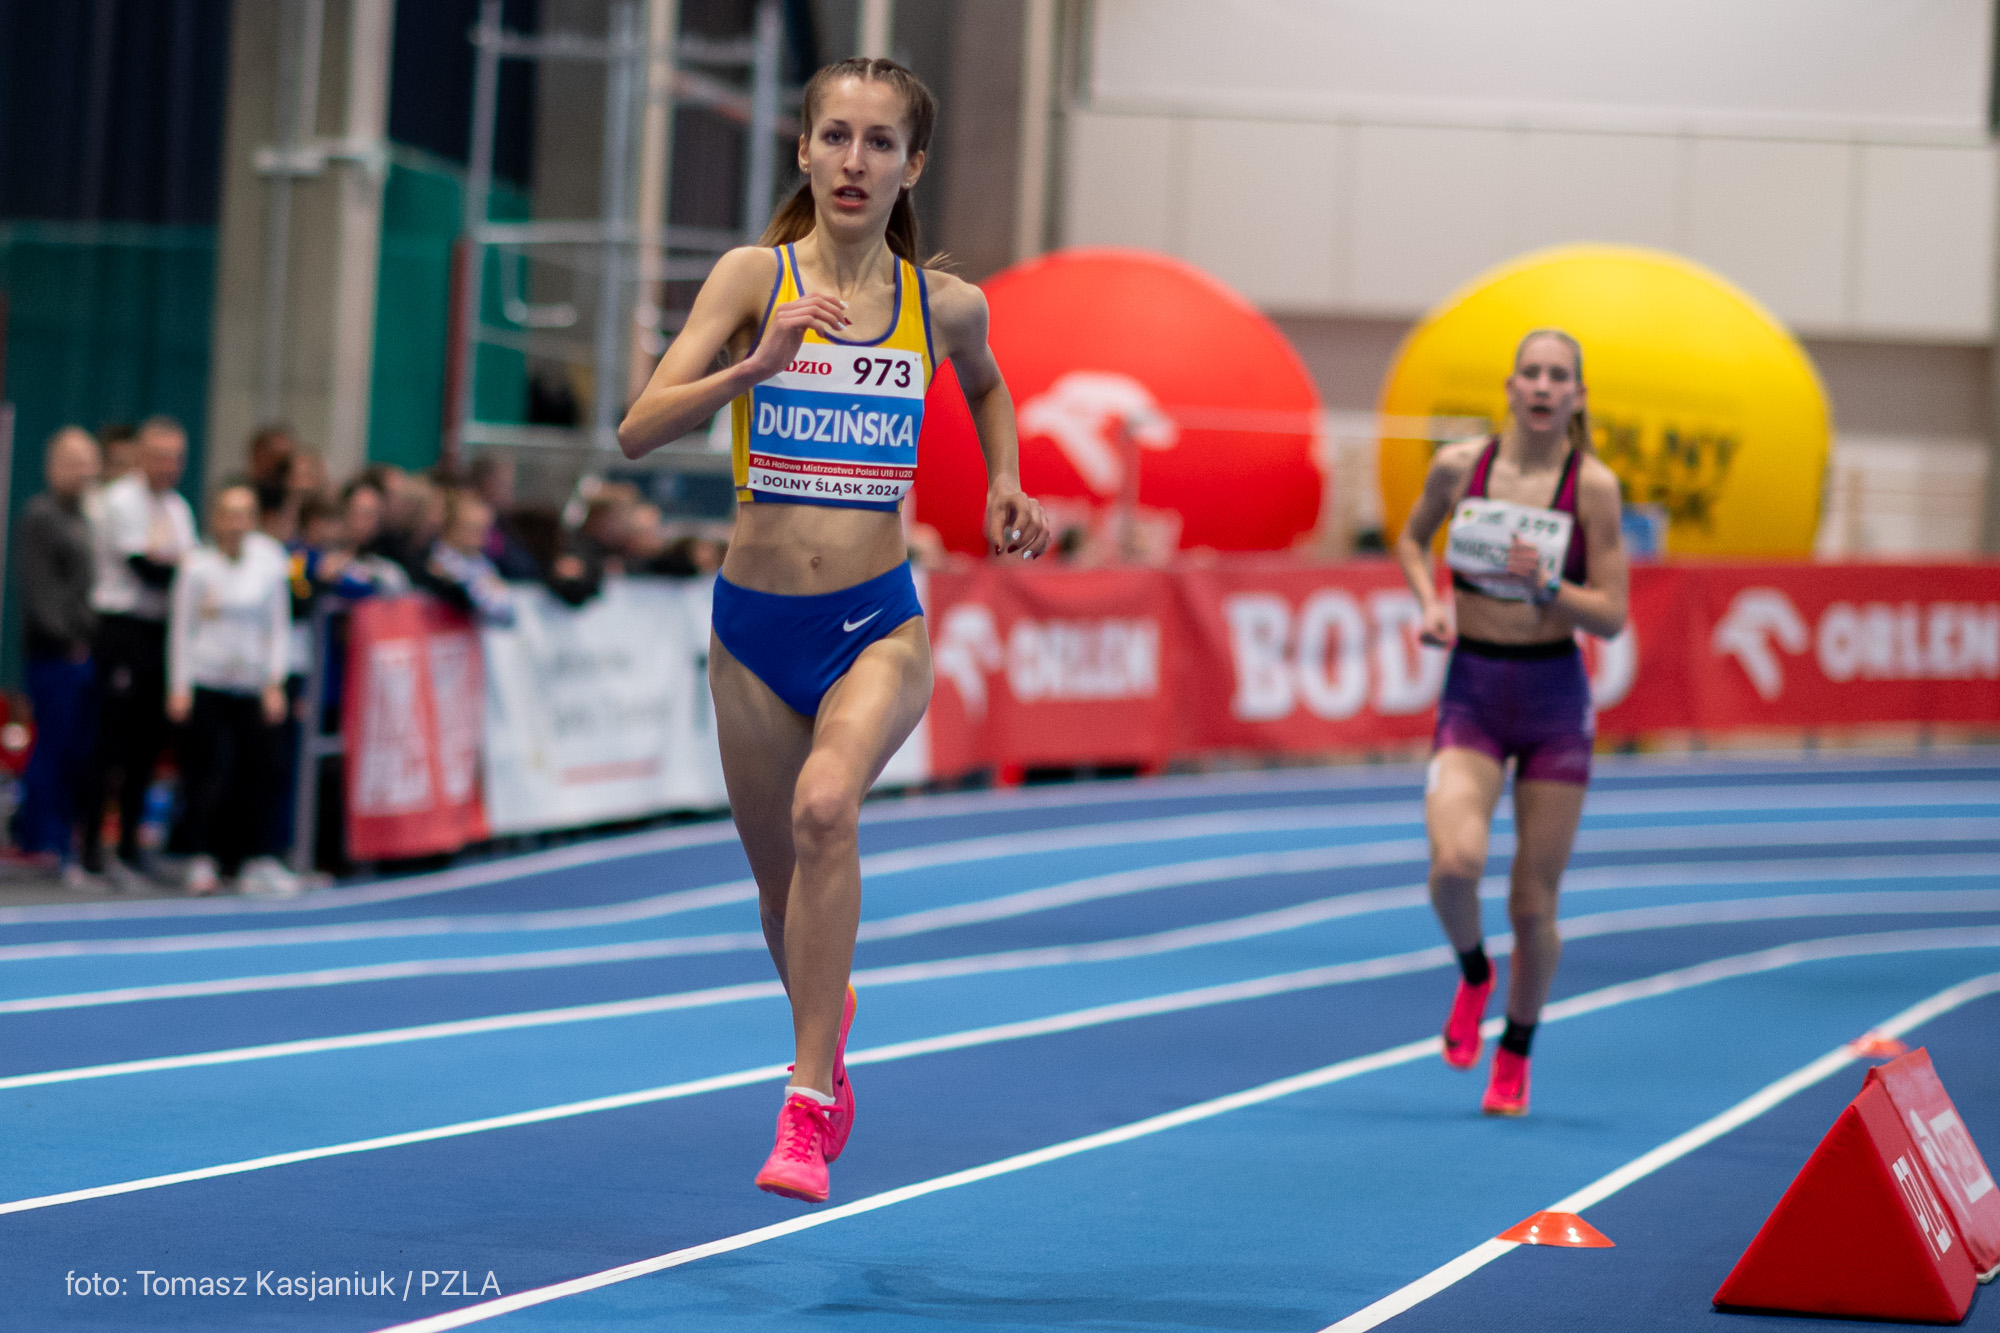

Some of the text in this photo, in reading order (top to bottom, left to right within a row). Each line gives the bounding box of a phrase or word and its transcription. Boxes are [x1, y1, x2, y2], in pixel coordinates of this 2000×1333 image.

[785, 360, 832, 375] DZIO
[853, 357, 911, 388] 973
[757, 402, 914, 447] DUDZIŃSKA
[753, 457, 771, 467] PZLA
[772, 460, 801, 471] Halowe
[803, 464, 854, 475] Mistrzostwa
[855, 467, 879, 477] Polski
[880, 469, 894, 478] U18
[899, 470, 913, 478] U20
[763, 475, 900, 496] DOLNY ŚLĄSK 2024
[1816, 600, 2000, 682] ORLEN
[1008, 619, 1160, 701] ORLEN
